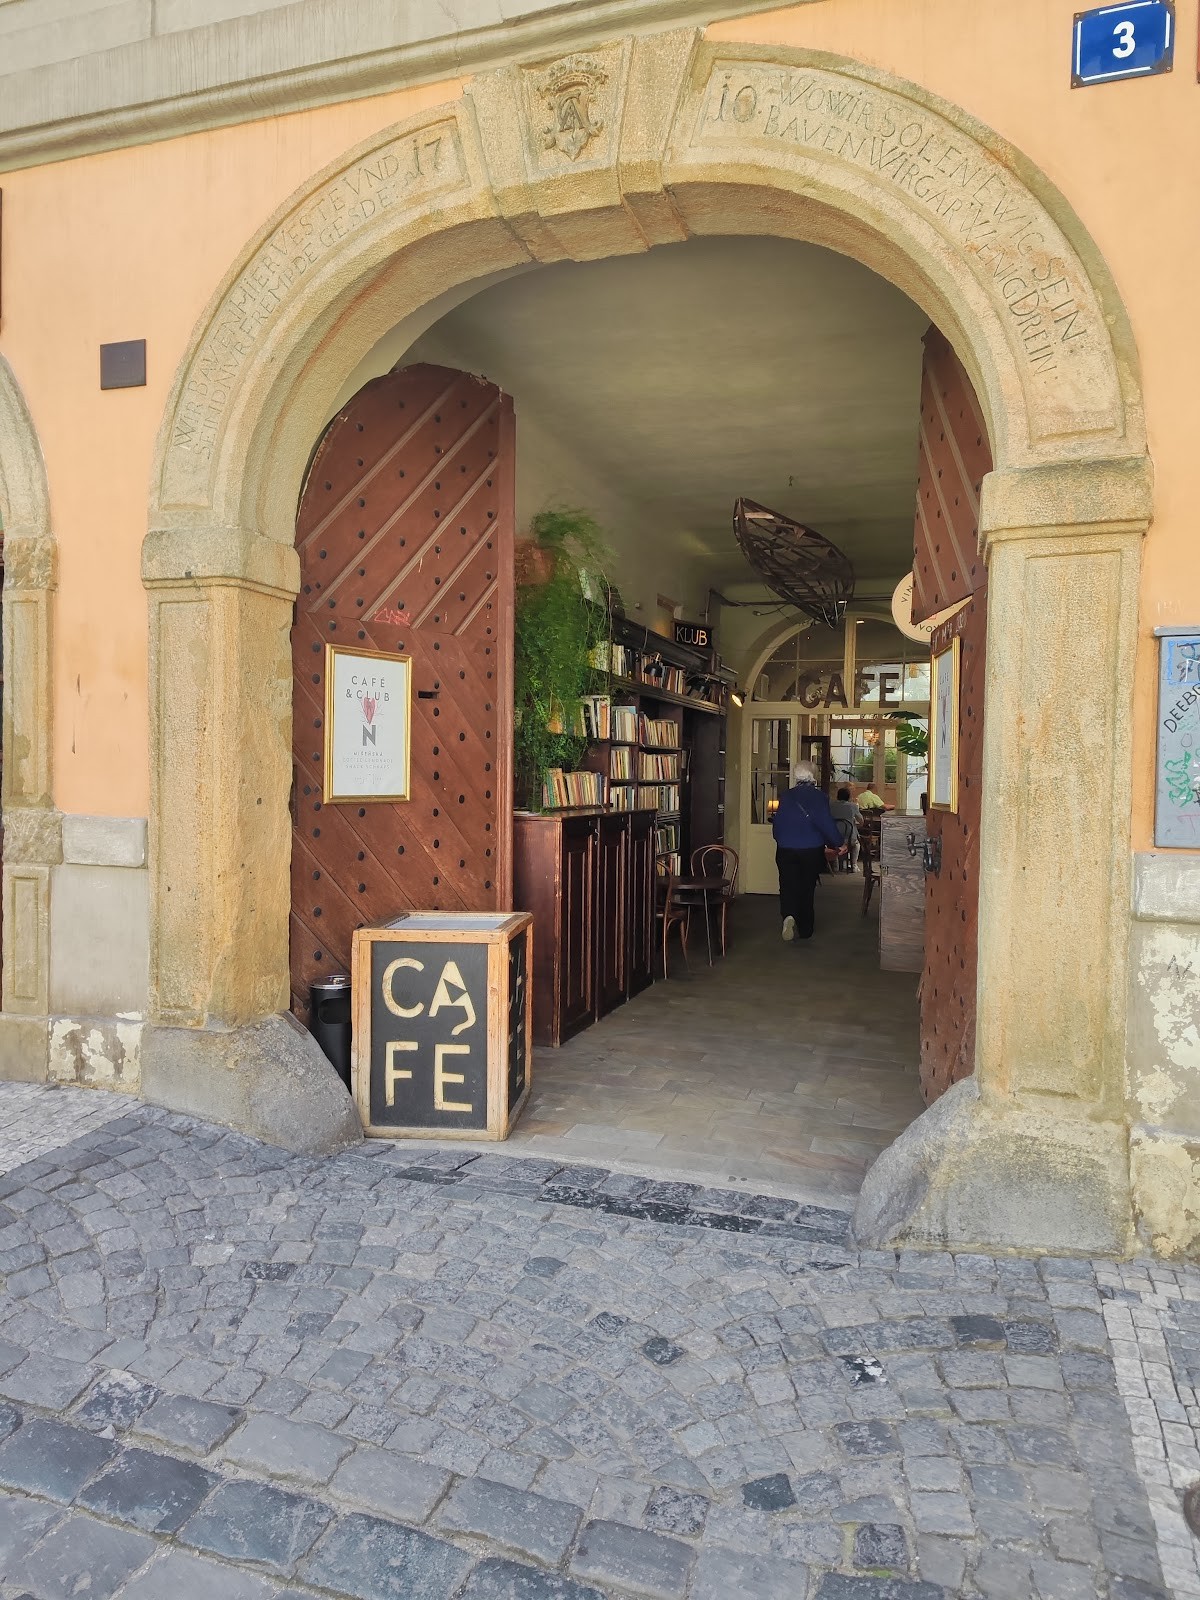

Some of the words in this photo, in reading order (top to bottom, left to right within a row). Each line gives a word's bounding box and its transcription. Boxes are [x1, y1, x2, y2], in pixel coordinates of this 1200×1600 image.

[1112, 21, 1136, 59] 3
[676, 626, 708, 646] KLUB
[351, 675, 385, 688] CAFÉ
[800, 671, 900, 708] CAFE
[345, 688, 353, 699] &
[356, 689, 390, 702] CLUB
[362, 725, 376, 746] N
